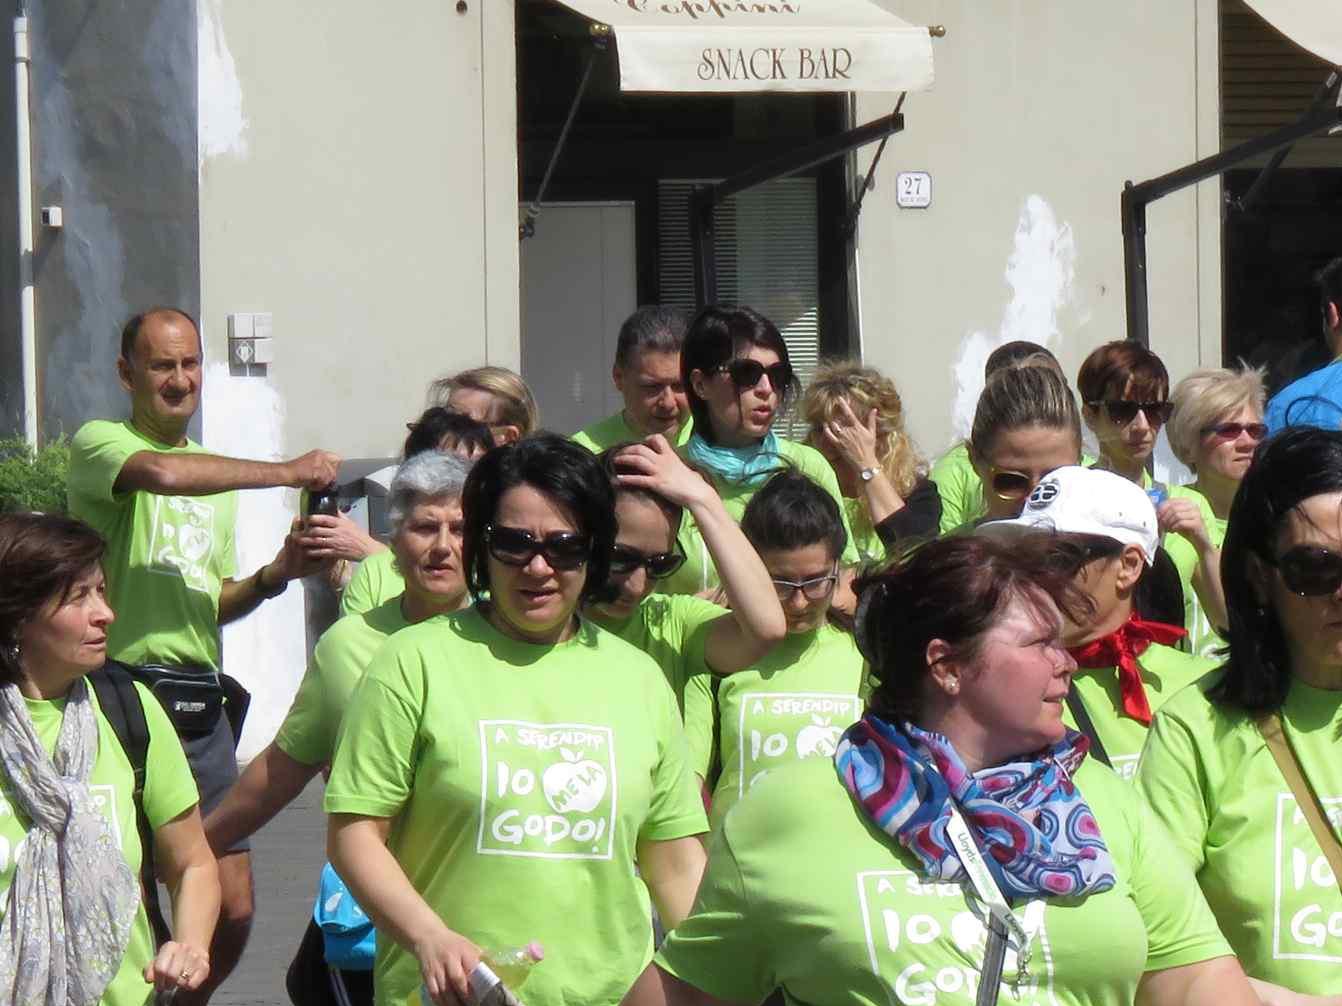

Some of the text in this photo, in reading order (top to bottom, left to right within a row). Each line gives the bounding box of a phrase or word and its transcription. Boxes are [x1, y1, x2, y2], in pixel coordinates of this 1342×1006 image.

[697, 47, 853, 80] SNACK BAR
[904, 176, 922, 195] 27
[752, 700, 765, 715] A
[496, 728, 605, 751] A SERENDIP
[552, 766, 604, 810] MELA
[492, 809, 606, 854] GODO!
[877, 878, 896, 893] A
